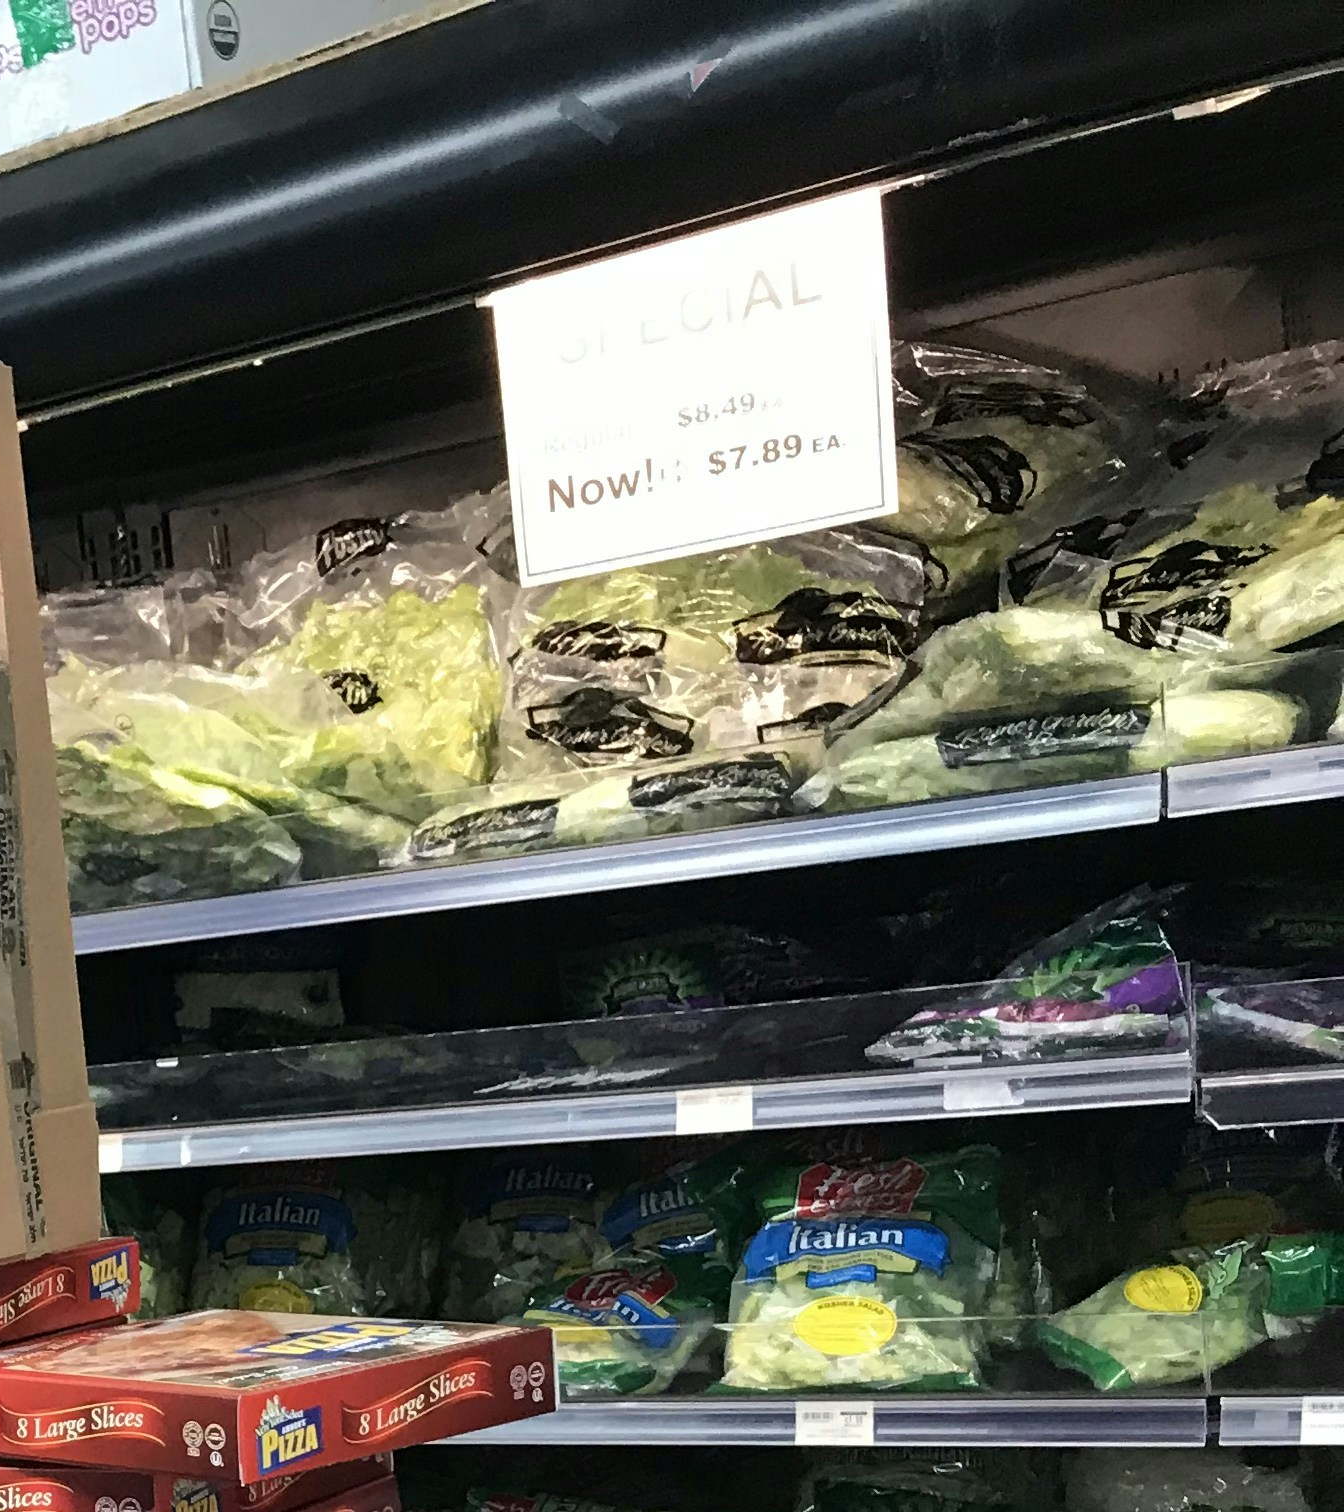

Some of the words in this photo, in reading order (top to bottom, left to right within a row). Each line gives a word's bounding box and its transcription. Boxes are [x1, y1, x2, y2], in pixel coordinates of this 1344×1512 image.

[546, 458, 654, 513] Now!
[708, 433, 802, 477] $7.89
[237, 1201, 322, 1227] Italian
[789, 1222, 903, 1254] Italian
[358, 1412, 371, 1435] 8
[373, 1393, 427, 1433] Large
[428, 1369, 477, 1405] Slices
[16, 1418, 29, 1438] 8
[32, 1412, 87, 1440] Large
[90, 1406, 145, 1430] Slices
[261, 1423, 319, 1470] PIZZA
